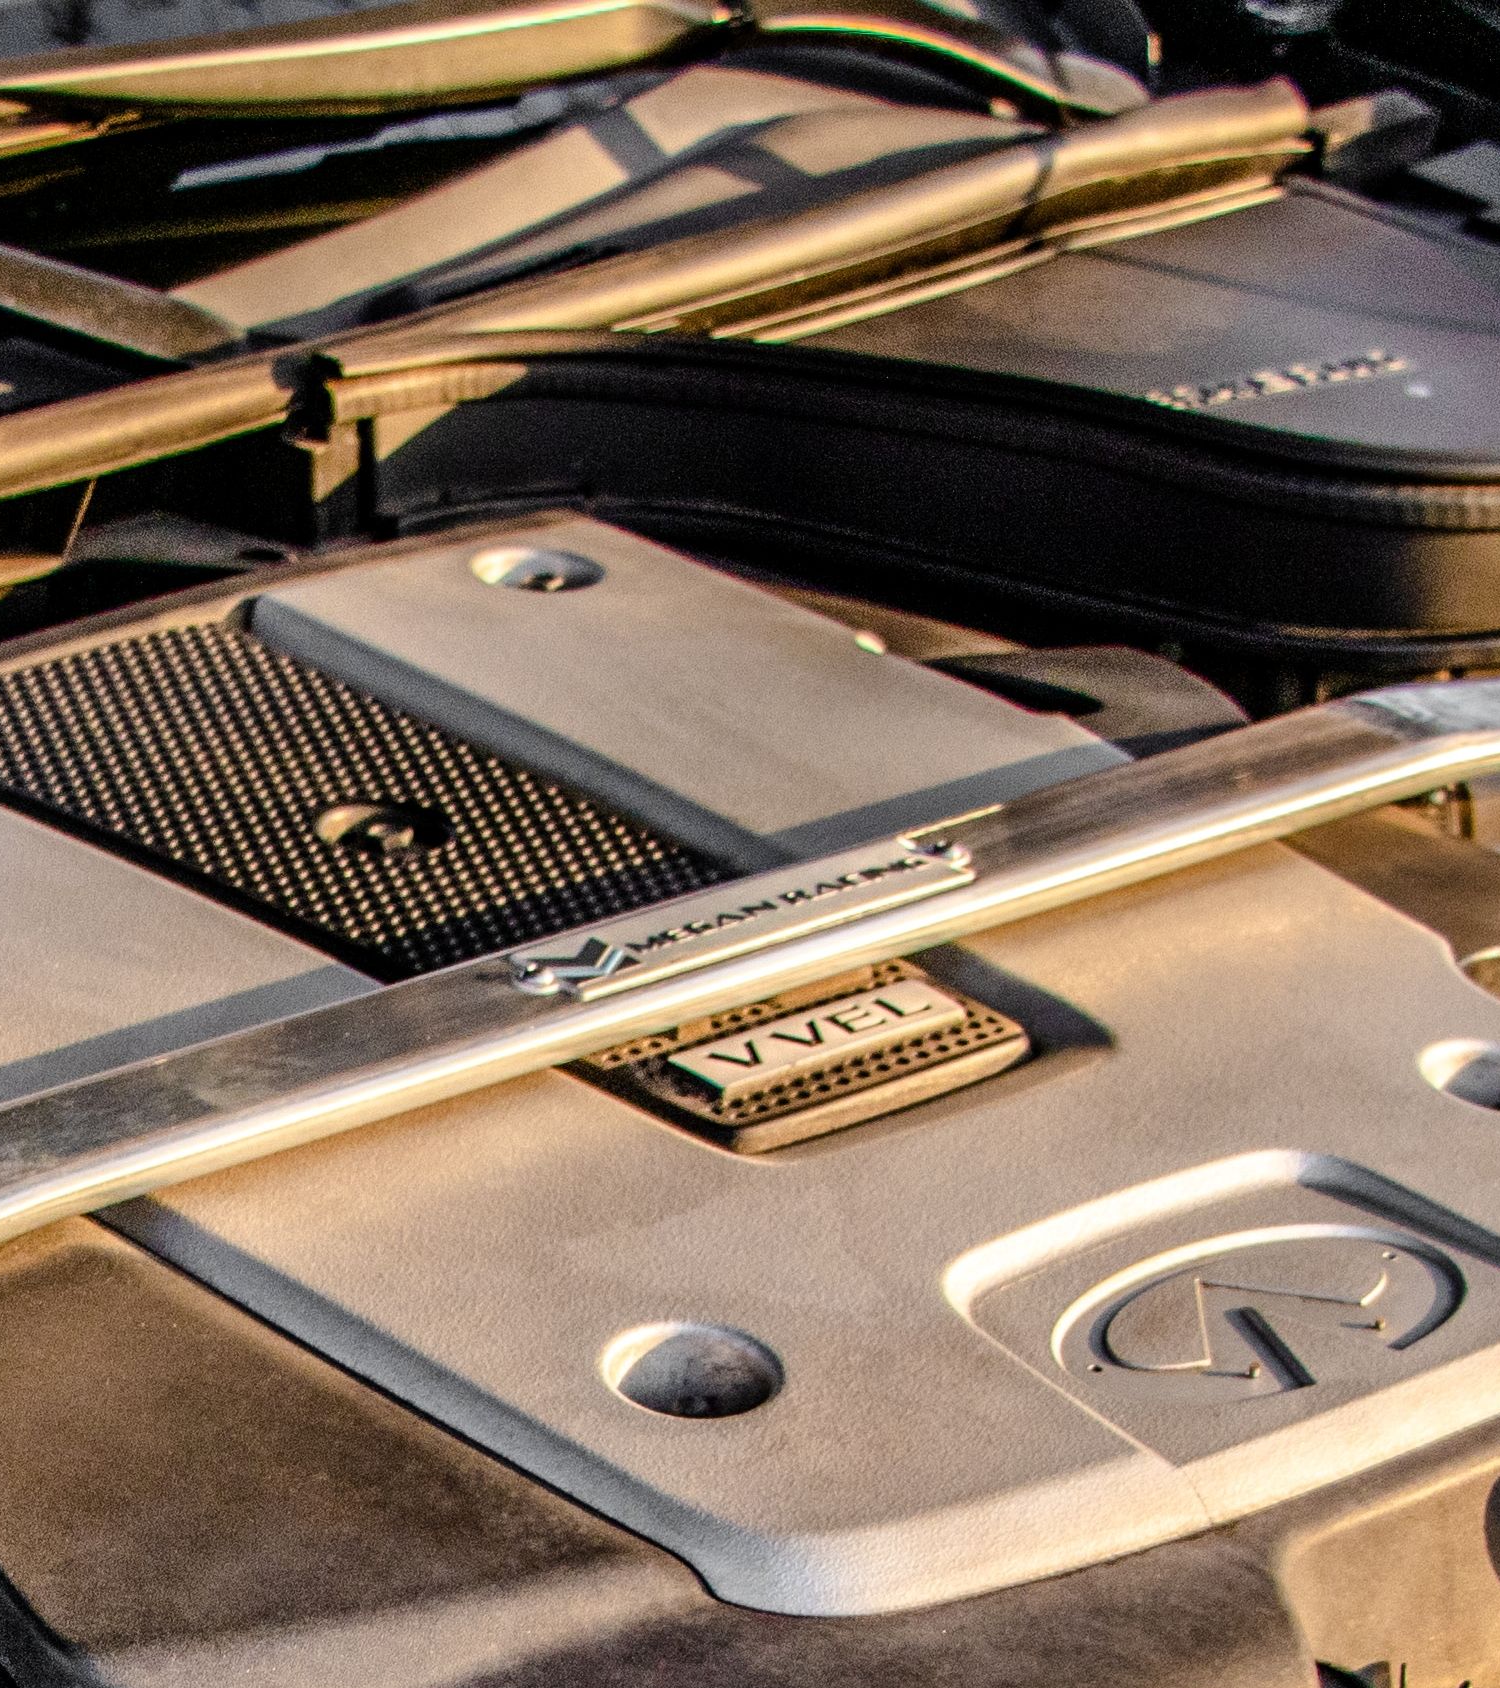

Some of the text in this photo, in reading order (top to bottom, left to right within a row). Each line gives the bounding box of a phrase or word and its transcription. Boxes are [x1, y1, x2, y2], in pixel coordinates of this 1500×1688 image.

[625, 857, 927, 953] MEGAN RACING
[708, 997, 931, 1068] VVEL
